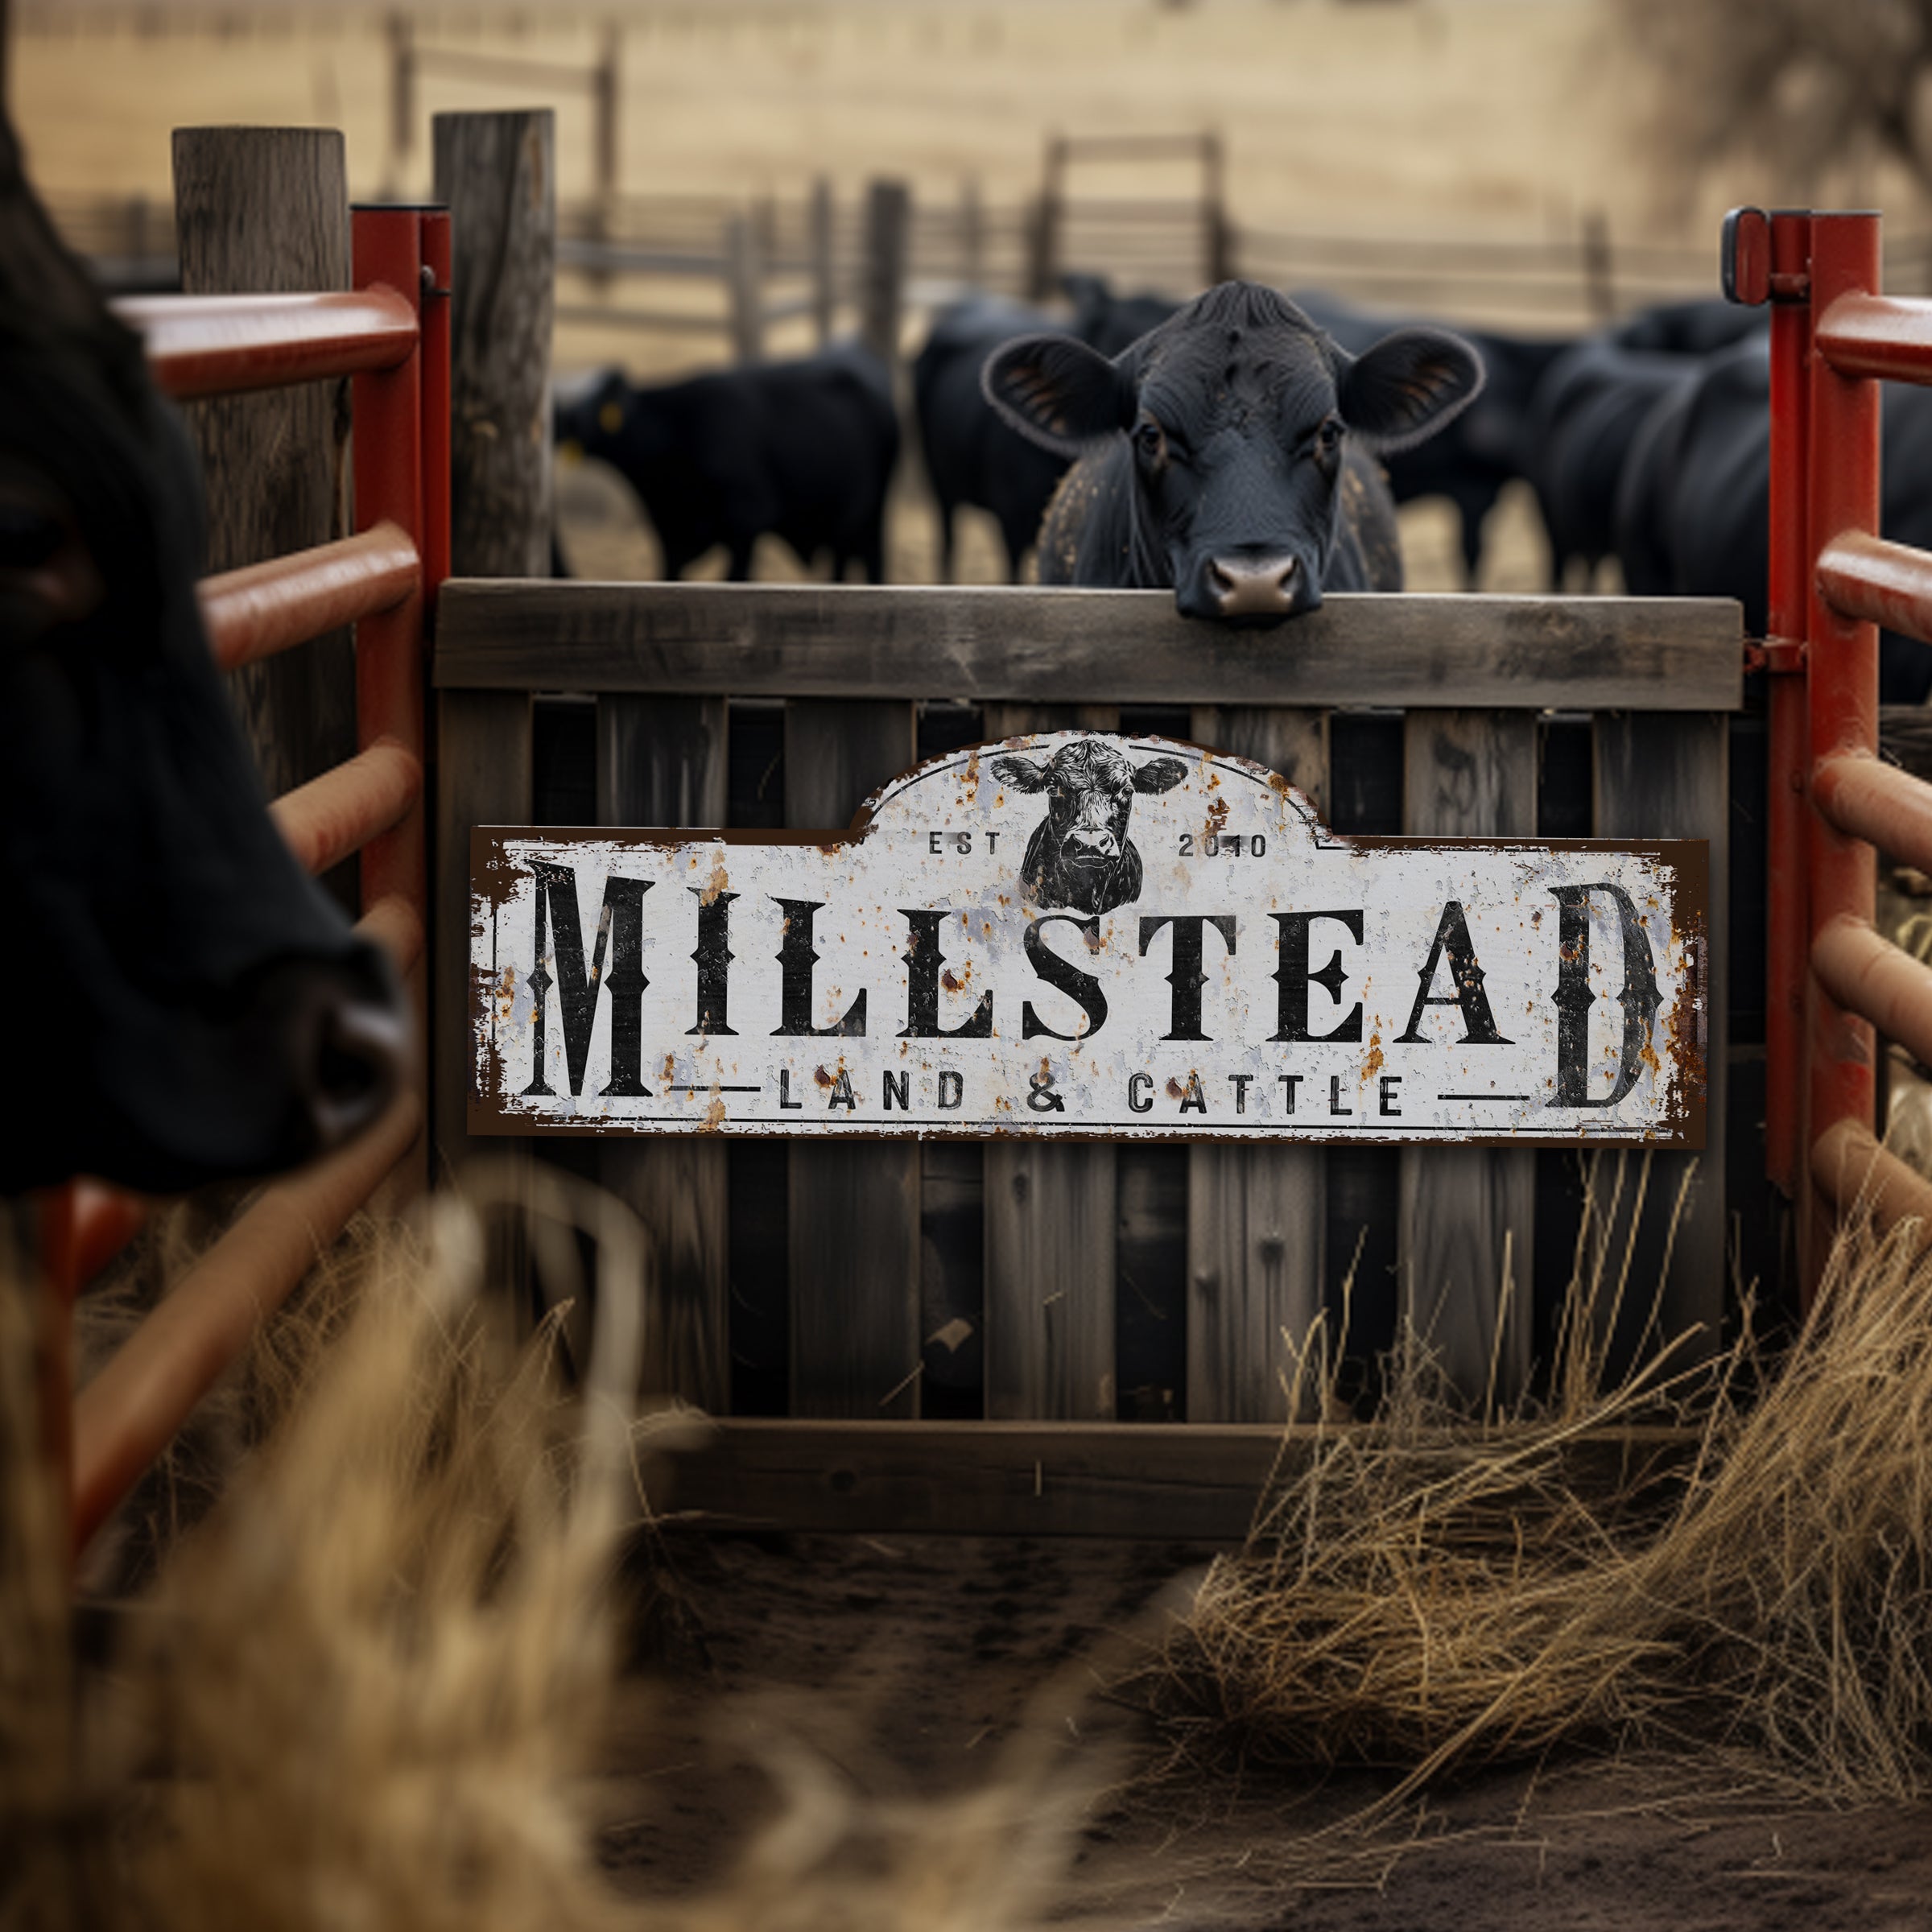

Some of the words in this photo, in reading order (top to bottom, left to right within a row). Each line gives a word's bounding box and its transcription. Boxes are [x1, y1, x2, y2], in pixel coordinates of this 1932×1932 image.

[928, 831, 1000, 855] EST
[1178, 832, 1266, 858] 2010
[520, 858, 1664, 1108] MILLSTEAD
[779, 1069, 964, 1111] LAND
[1026, 1071, 1065, 1113] &
[1128, 1071, 1402, 1116] CATTLE
